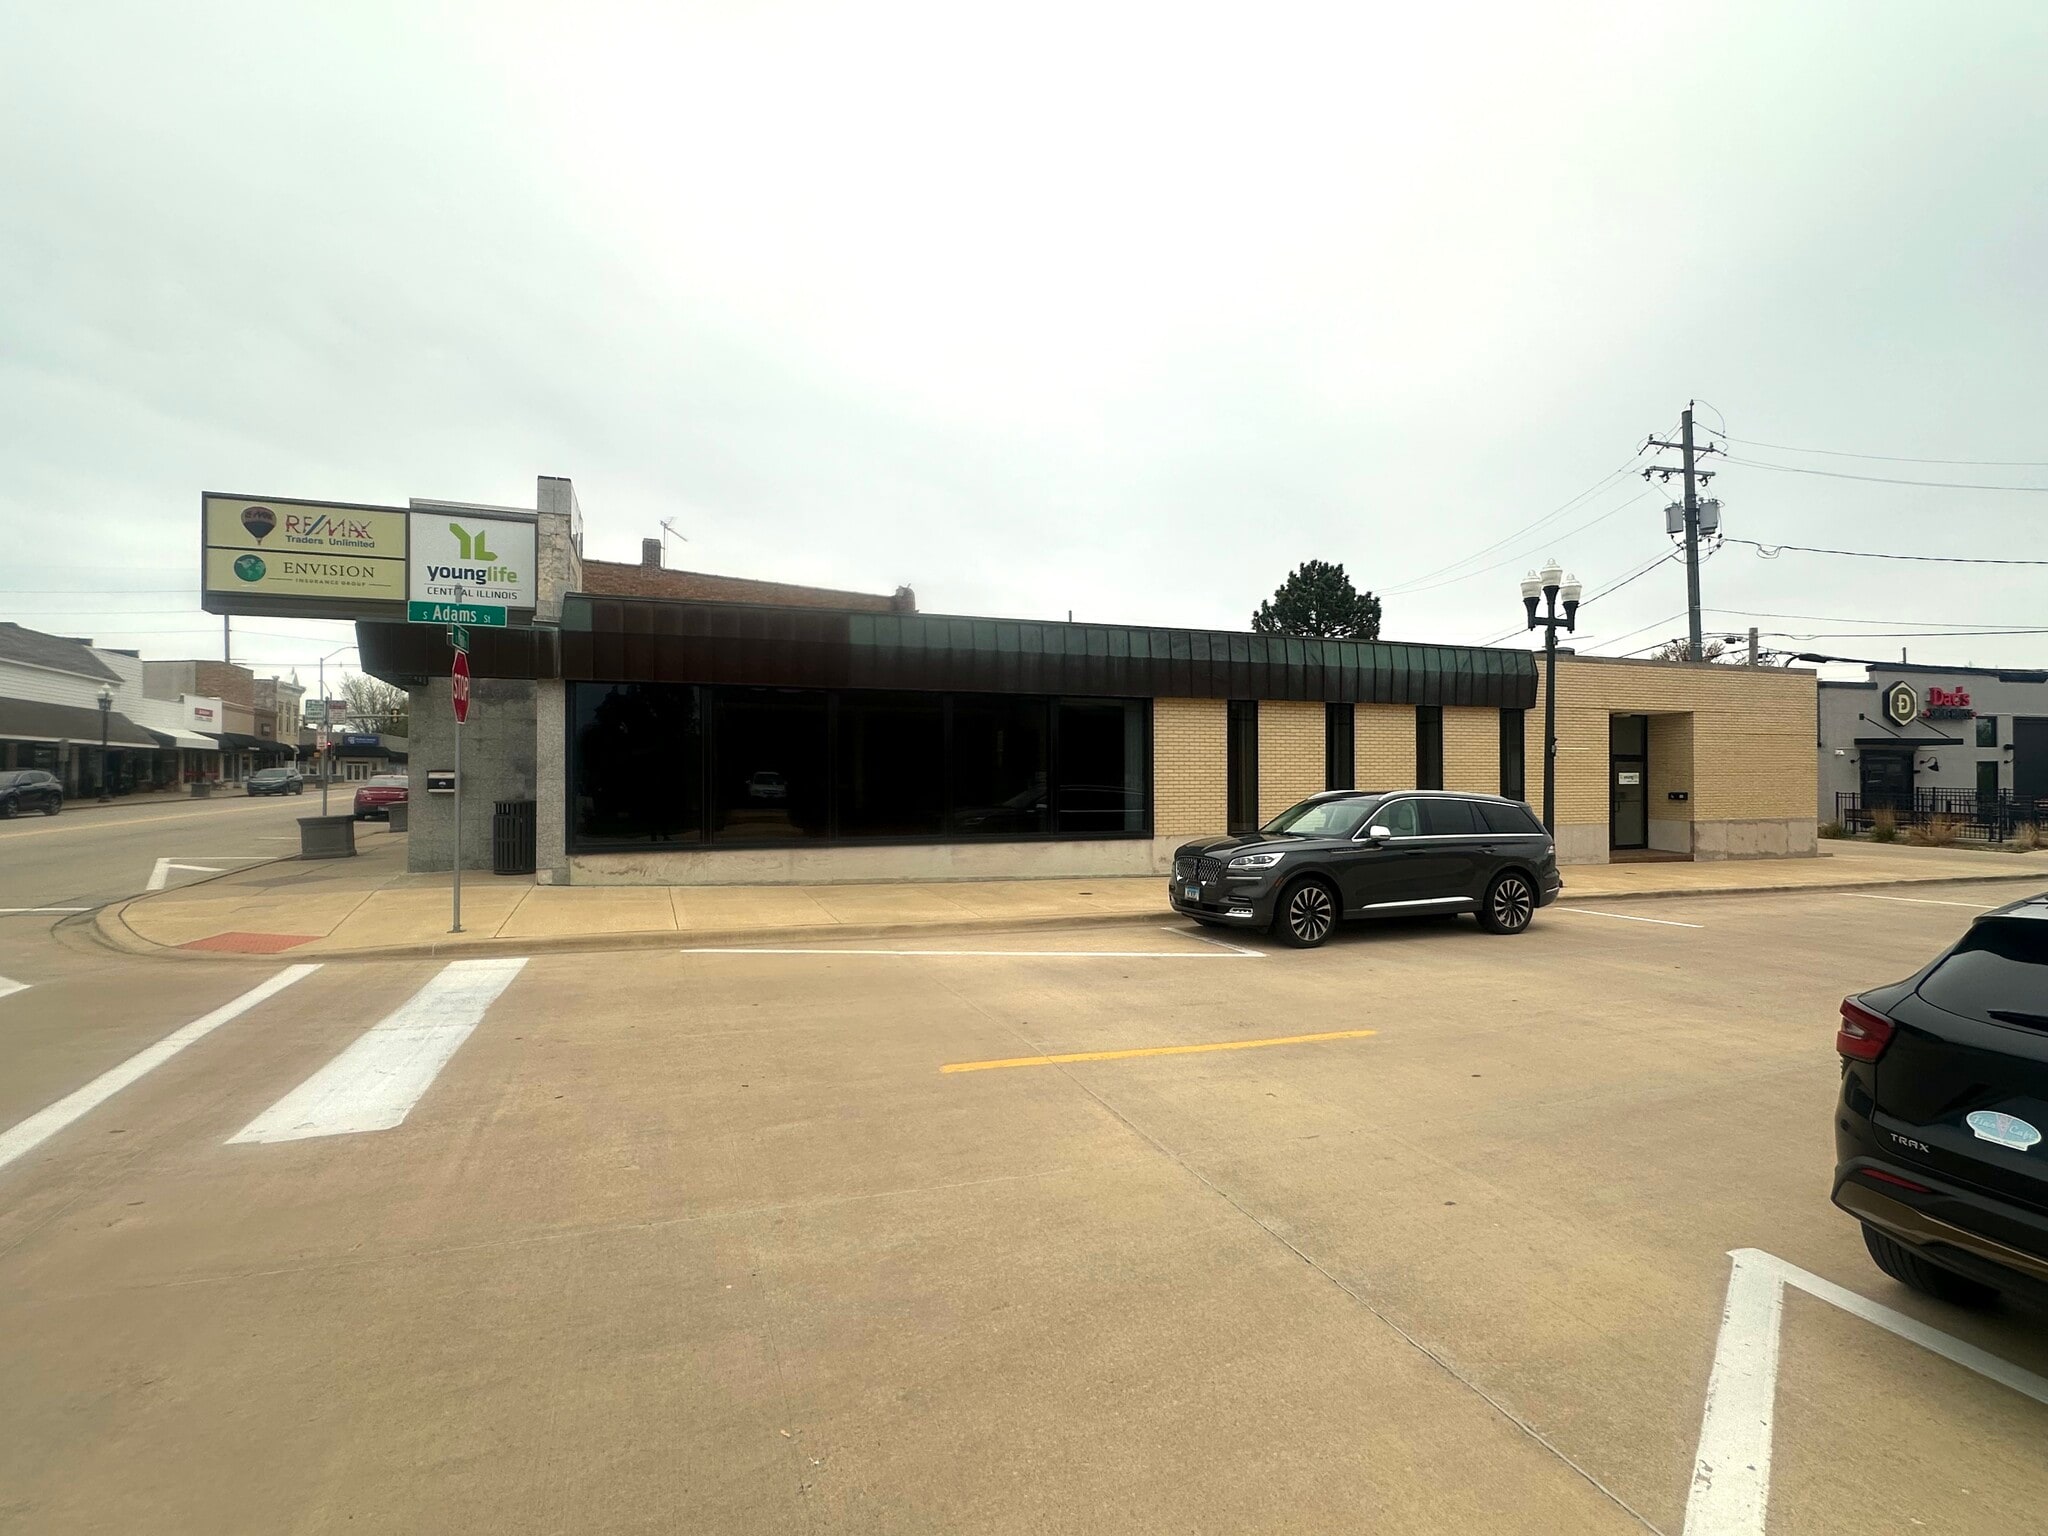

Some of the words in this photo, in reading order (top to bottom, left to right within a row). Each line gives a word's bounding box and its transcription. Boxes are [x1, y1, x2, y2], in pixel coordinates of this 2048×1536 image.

[285, 514, 373, 539] RE/MAX
[285, 535, 323, 545] Traders
[329, 538, 375, 549] Unlimited
[283, 561, 376, 578] ENVISION
[295, 578, 339, 586] INSURANCE
[476, 590, 518, 600] ILLINOIS
[423, 611, 428, 620] S
[432, 604, 477, 623] Adams
[483, 614, 491, 624] St
[454, 673, 469, 701] STOP
[1890, 1133, 1930, 1153] TRAX
